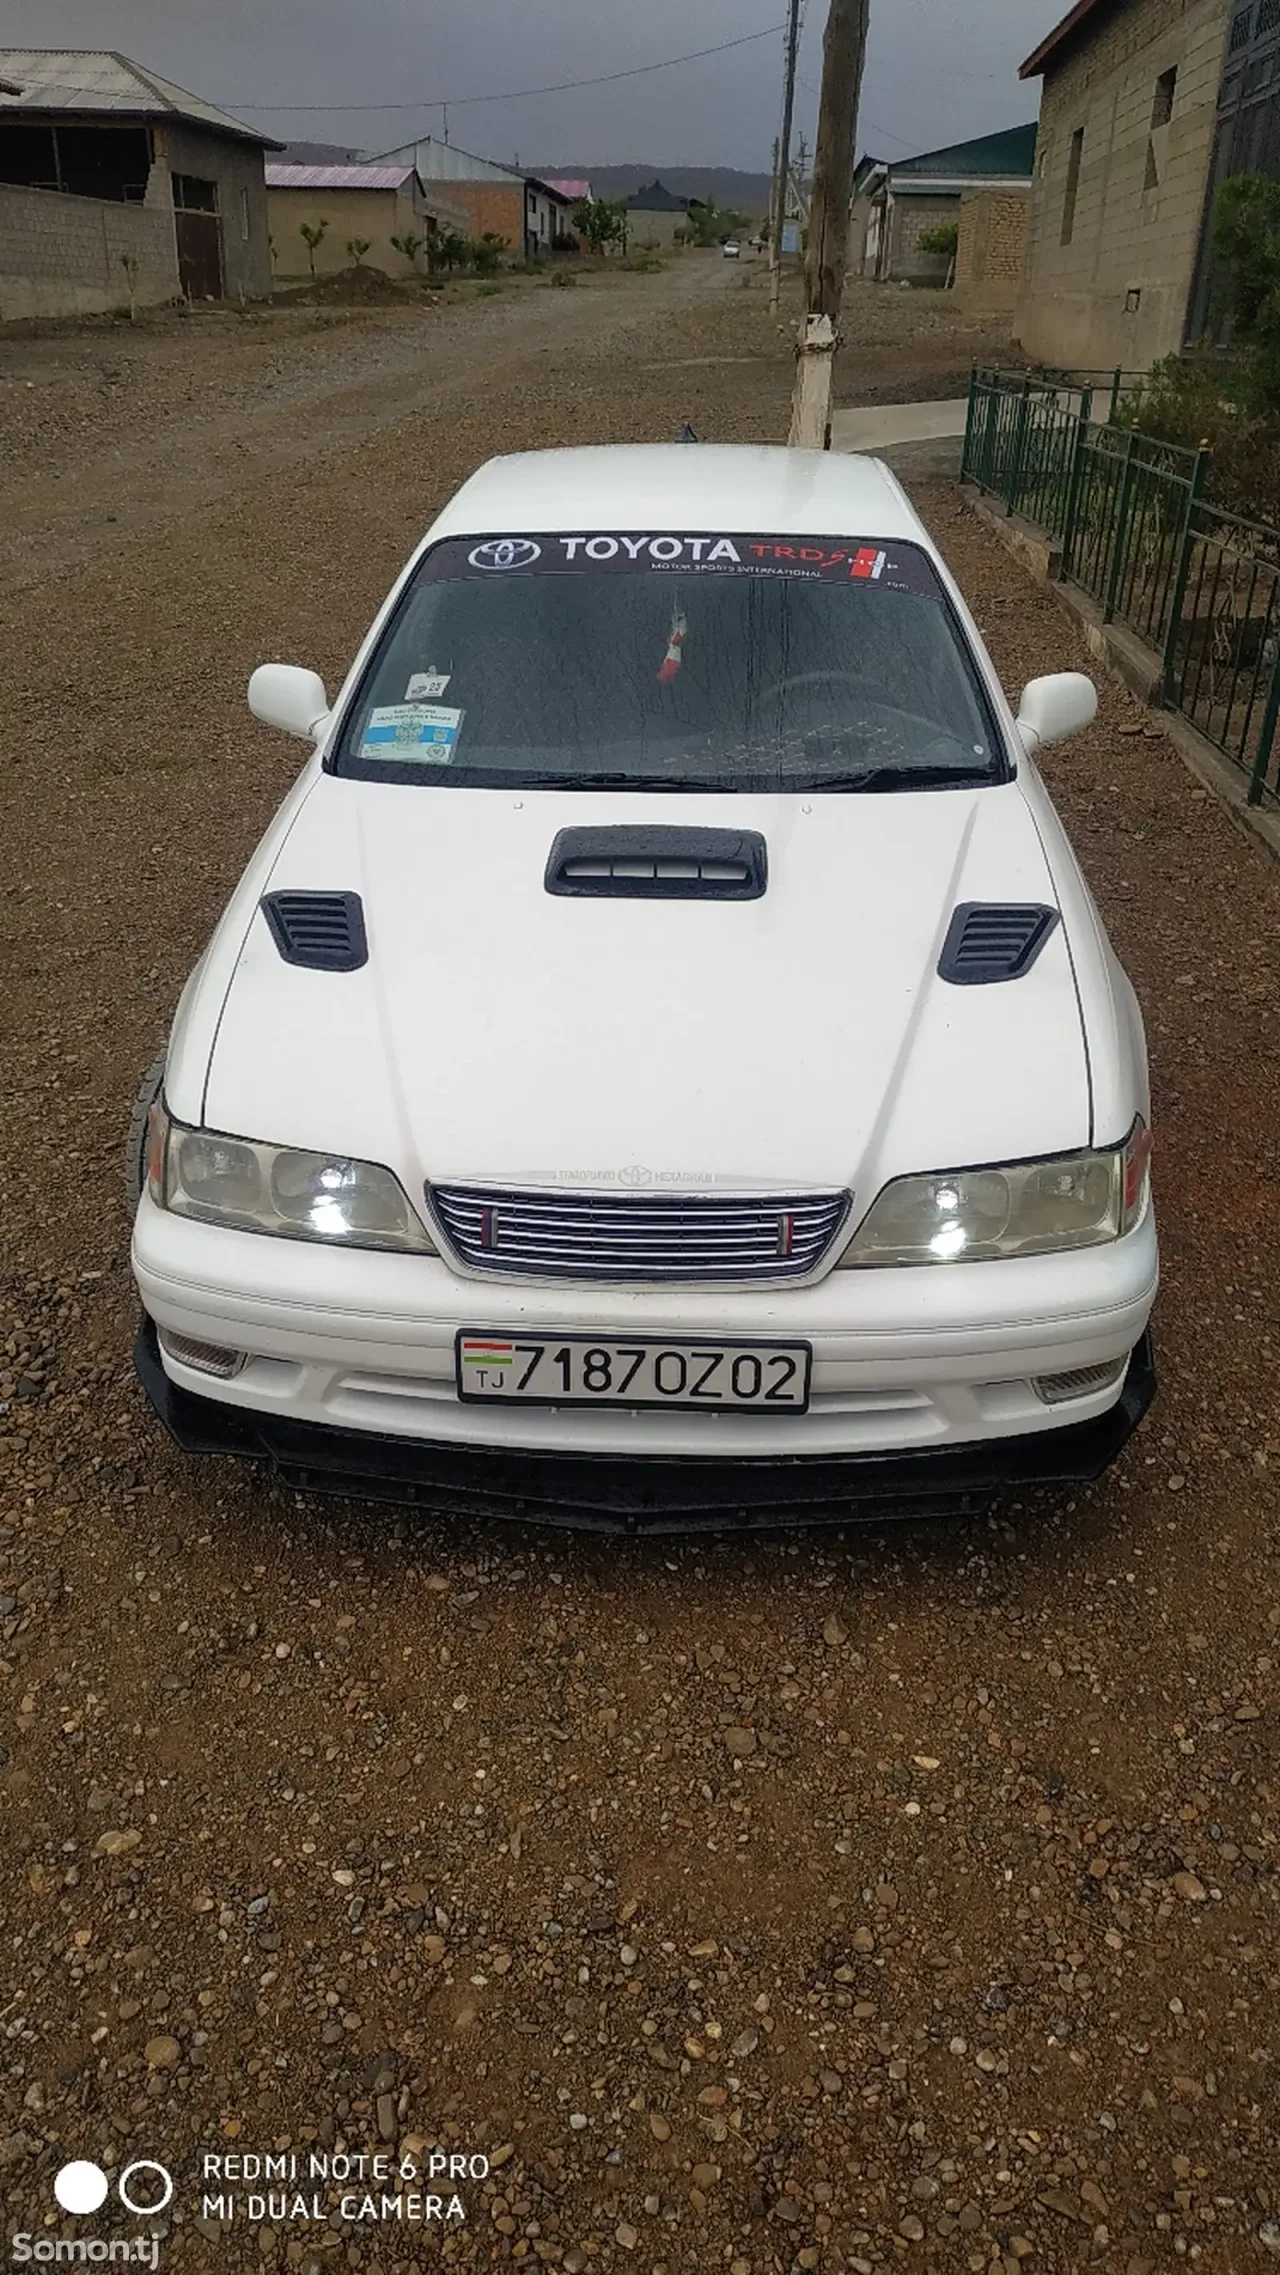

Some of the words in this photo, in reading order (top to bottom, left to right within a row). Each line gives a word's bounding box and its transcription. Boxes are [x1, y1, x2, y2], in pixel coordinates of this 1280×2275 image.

[559, 537, 742, 563] TOYOTA
[651, 562, 692, 572] MOTOR
[694, 563, 735, 573] SPORTS
[737, 565, 823, 578] INTERNATIONAL
[475, 1370, 505, 1389] TJ
